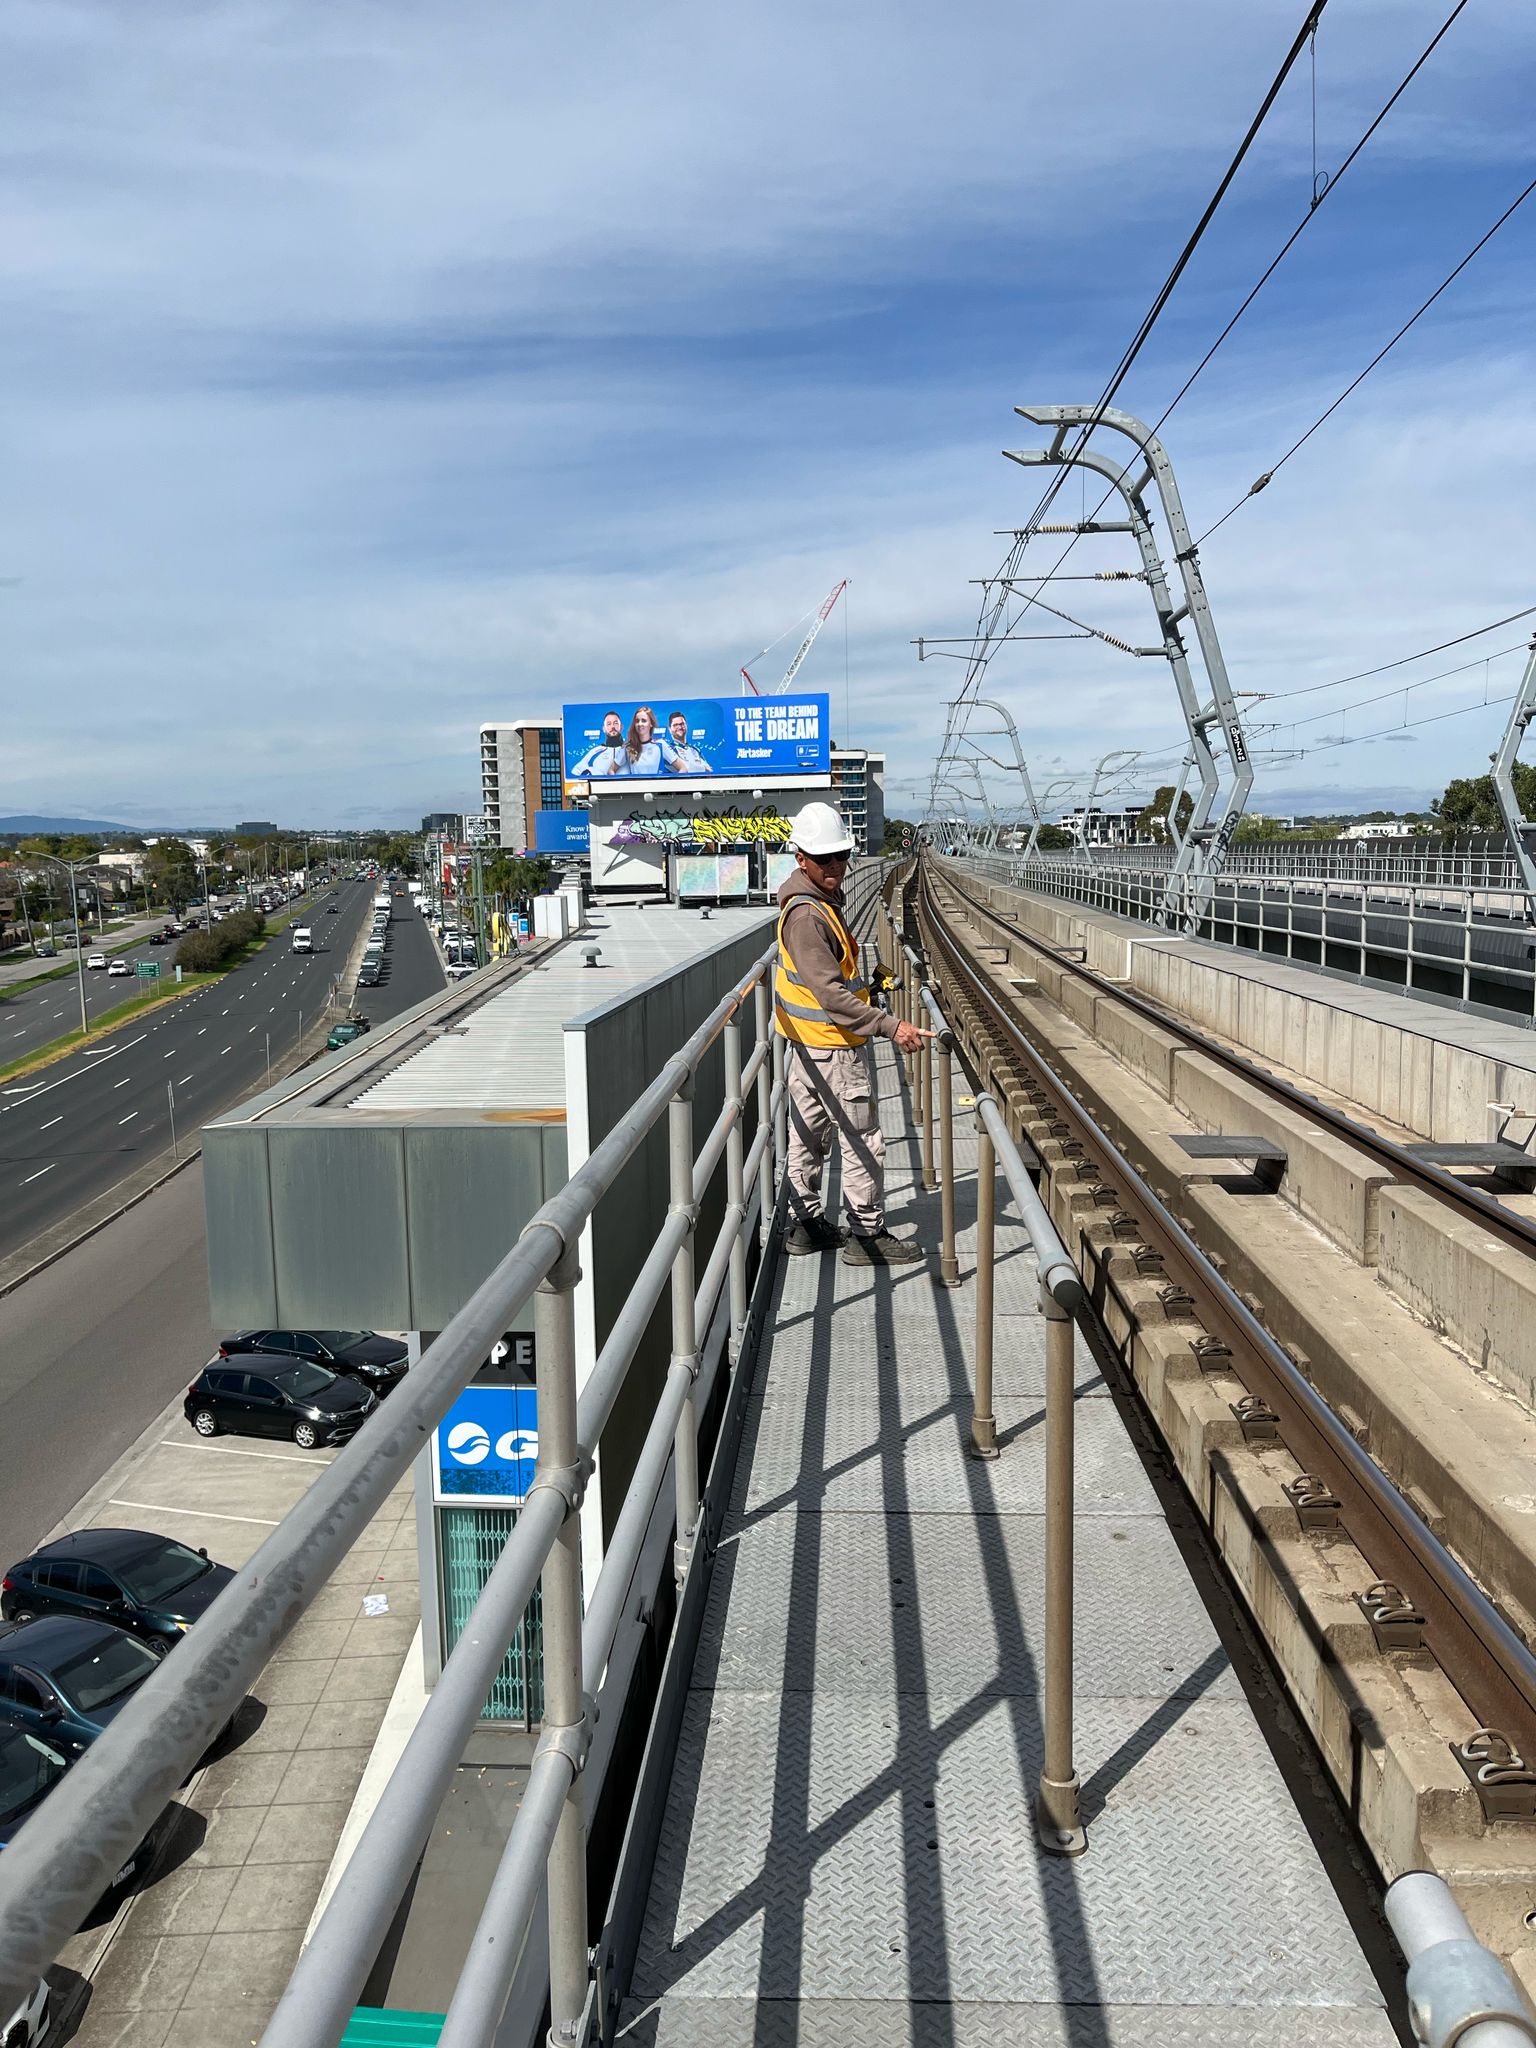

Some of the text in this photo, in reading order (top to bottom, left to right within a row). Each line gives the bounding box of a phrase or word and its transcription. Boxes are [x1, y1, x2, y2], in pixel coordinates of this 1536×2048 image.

[735, 704, 819, 720] TO THE TEAM BEHIND
[735, 718, 819, 742] THE DREAM
[736, 748, 773, 759] Airtasker
[565, 825, 586, 833] Know
